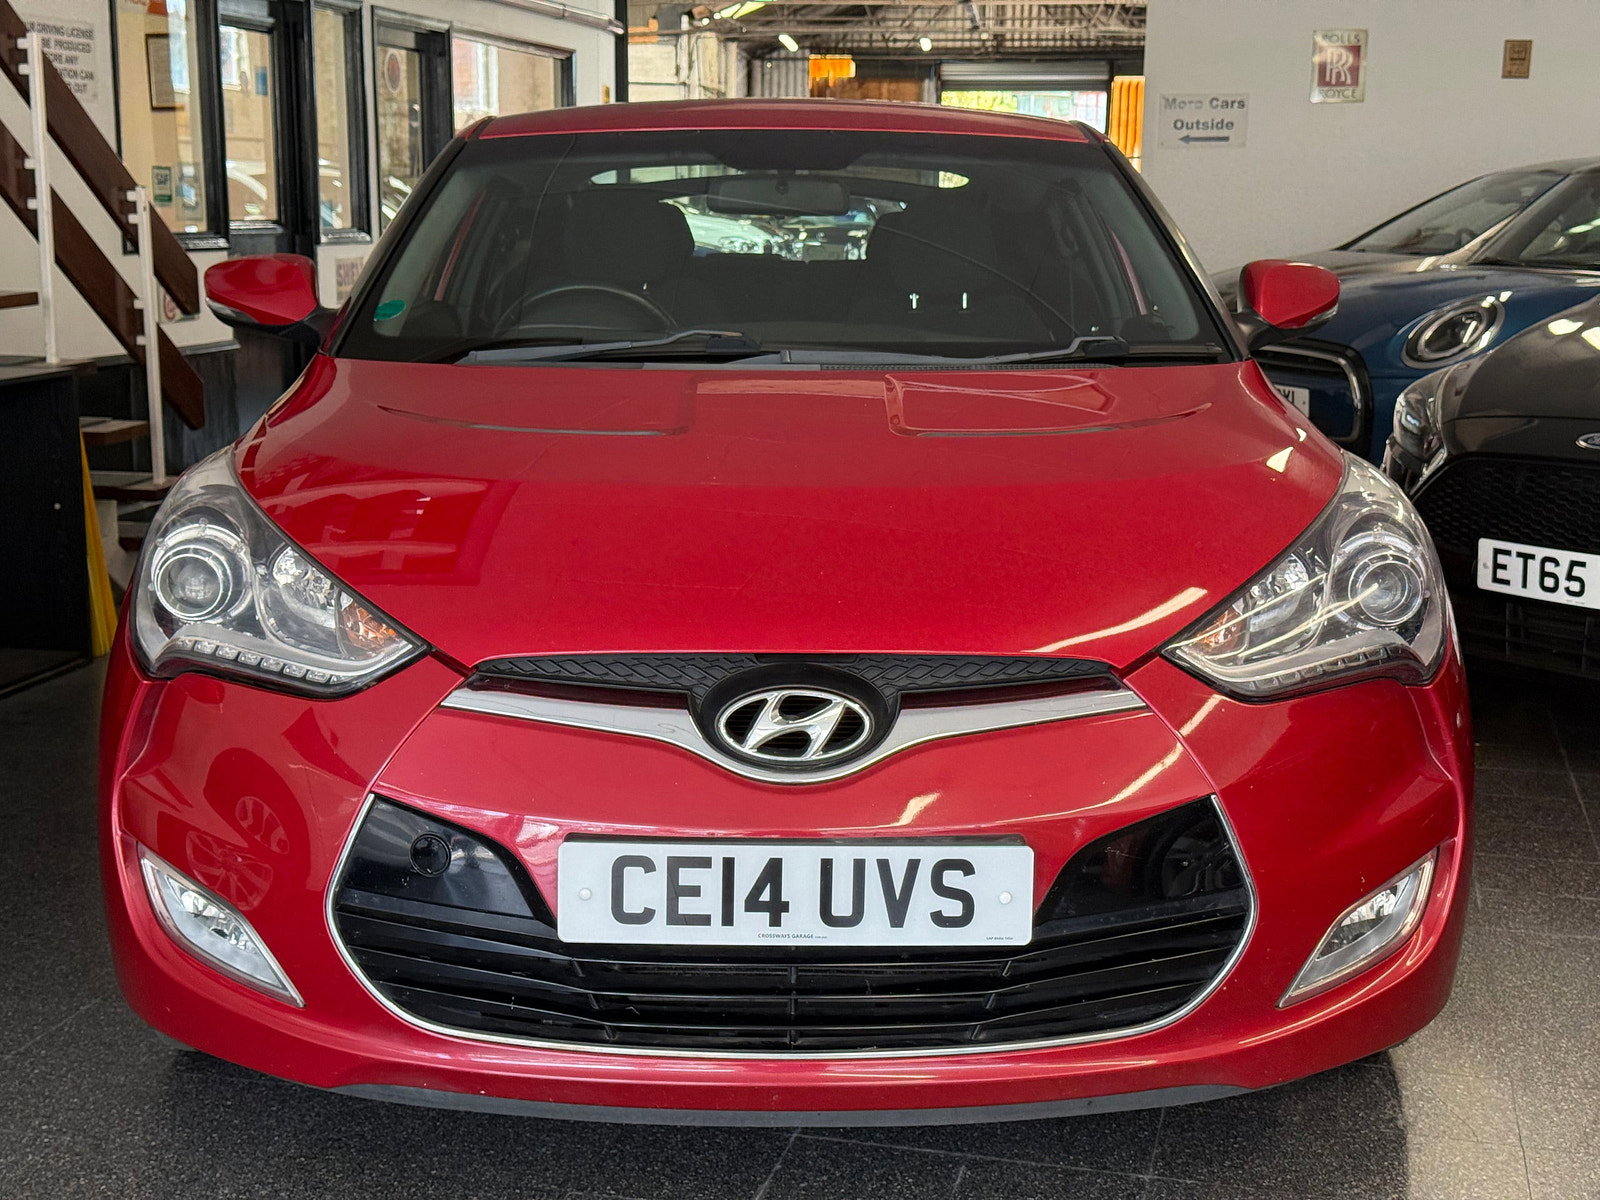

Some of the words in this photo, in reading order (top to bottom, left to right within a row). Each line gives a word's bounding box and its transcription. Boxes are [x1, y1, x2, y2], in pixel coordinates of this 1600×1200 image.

[1209, 97, 1246, 110] Cars
[1173, 118, 1235, 131] Outside
[1491, 547, 1587, 598] ET65
[611, 854, 790, 928] CE14
[819, 857, 976, 929] UVS
